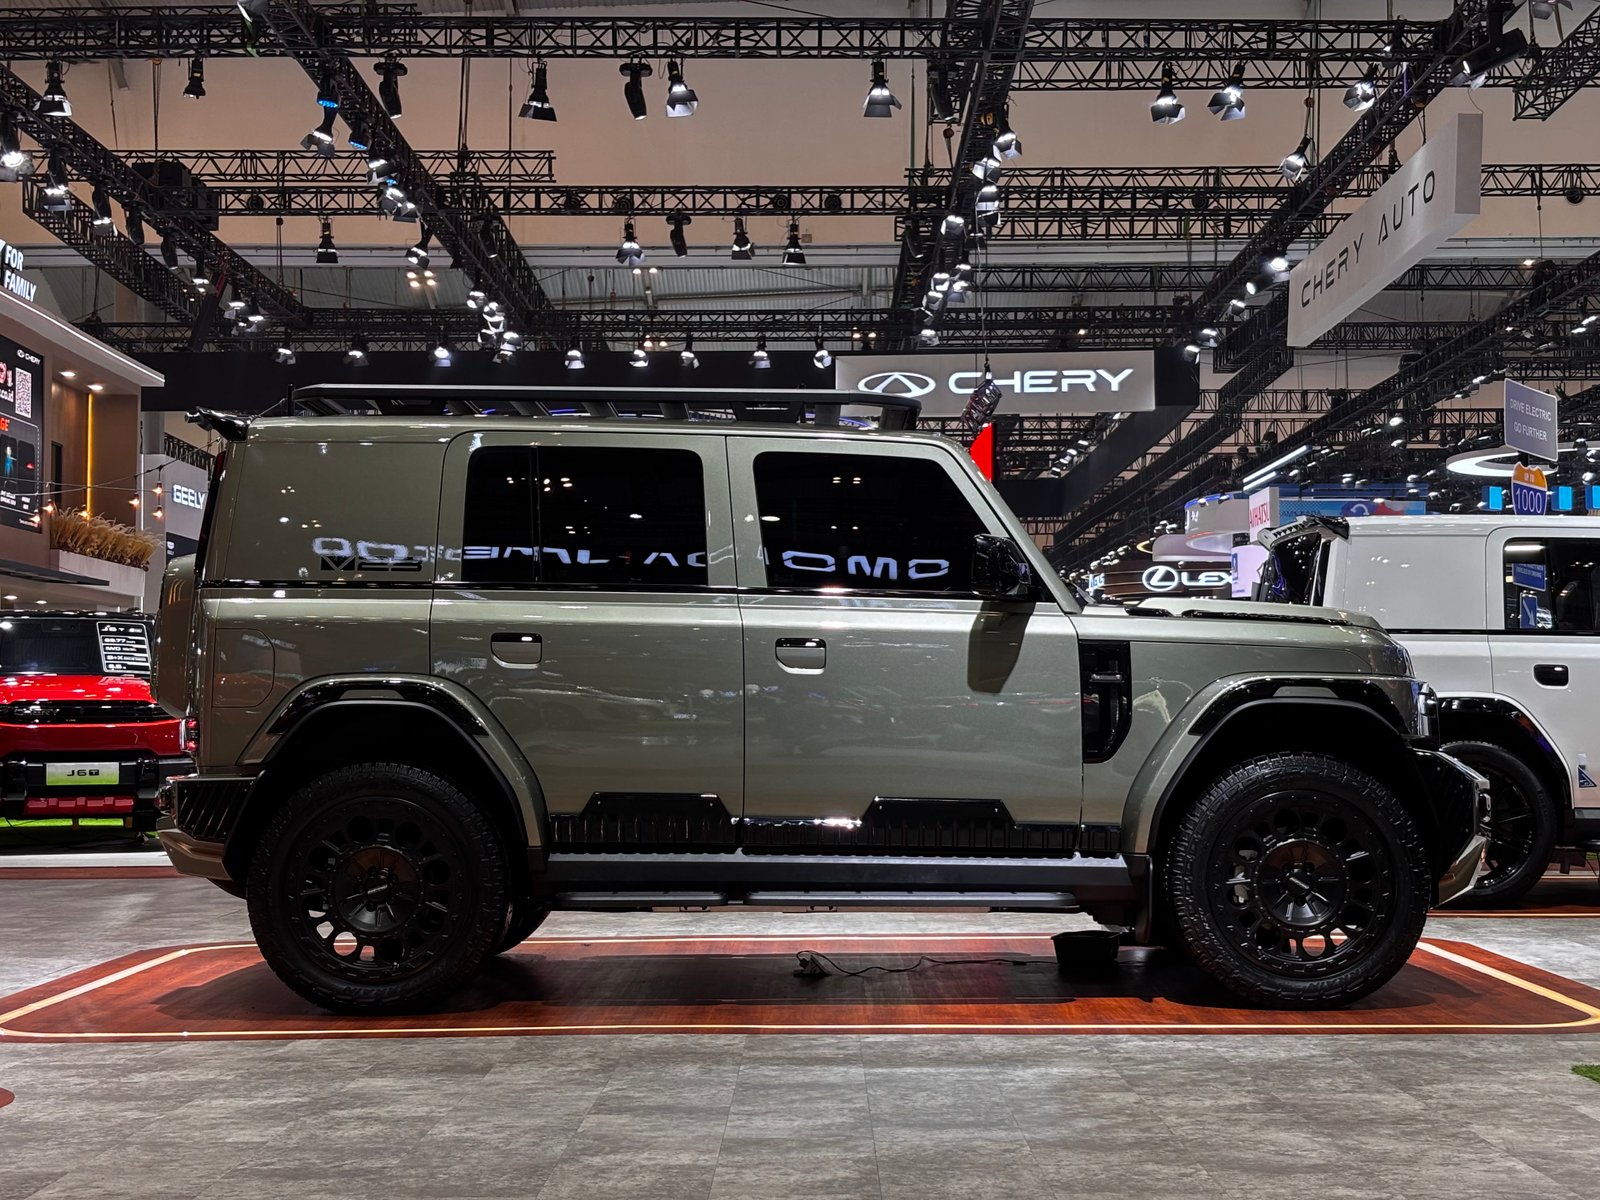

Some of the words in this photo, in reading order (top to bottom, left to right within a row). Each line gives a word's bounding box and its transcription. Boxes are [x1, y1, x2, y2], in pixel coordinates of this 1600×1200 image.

[1301, 232, 1364, 308] CHERY
[1377, 170, 1436, 246] AUTO
[5, 244, 24, 272] FOR
[4, 269, 37, 302] FAMILY
[948, 369, 1134, 394] CHERY
[1510, 398, 1525, 413] DRIVE
[1525, 403, 1552, 422] ELECTRIC
[1513, 421, 1522, 433] GO
[1522, 424, 1548, 441] FURTHER
[173, 484, 205, 510] GEELY
[1516, 487, 1542, 514] 1000
